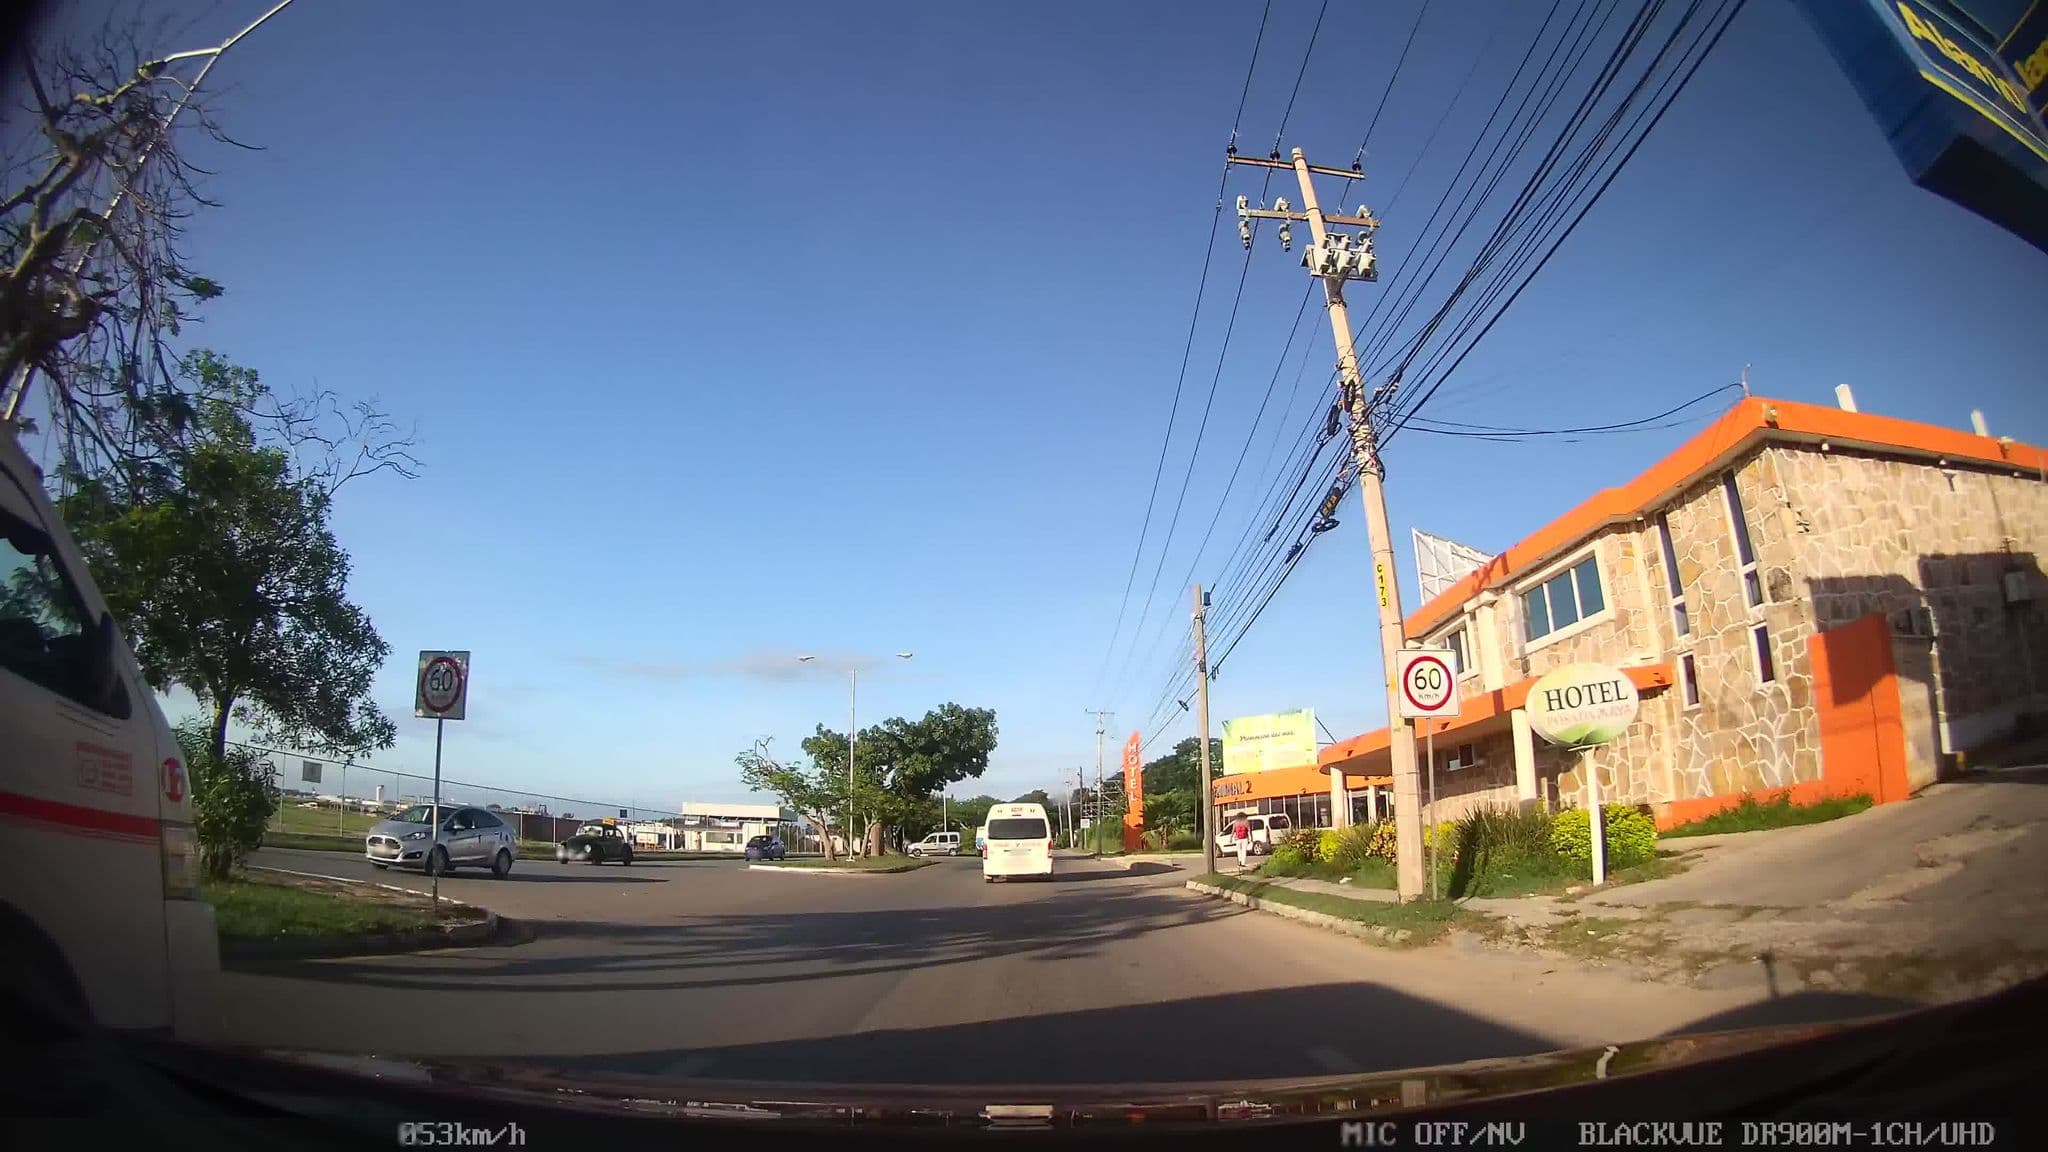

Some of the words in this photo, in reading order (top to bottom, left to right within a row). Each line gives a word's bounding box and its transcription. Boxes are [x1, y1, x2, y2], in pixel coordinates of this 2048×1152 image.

[1376, 564, 1387, 607] C173
[430, 668, 453, 690] 60
[1414, 667, 1441, 690] 60
[1544, 680, 1628, 712] HOTEL
[1127, 742, 1139, 802] HOTEL
[1245, 779, 1254, 794] 2
